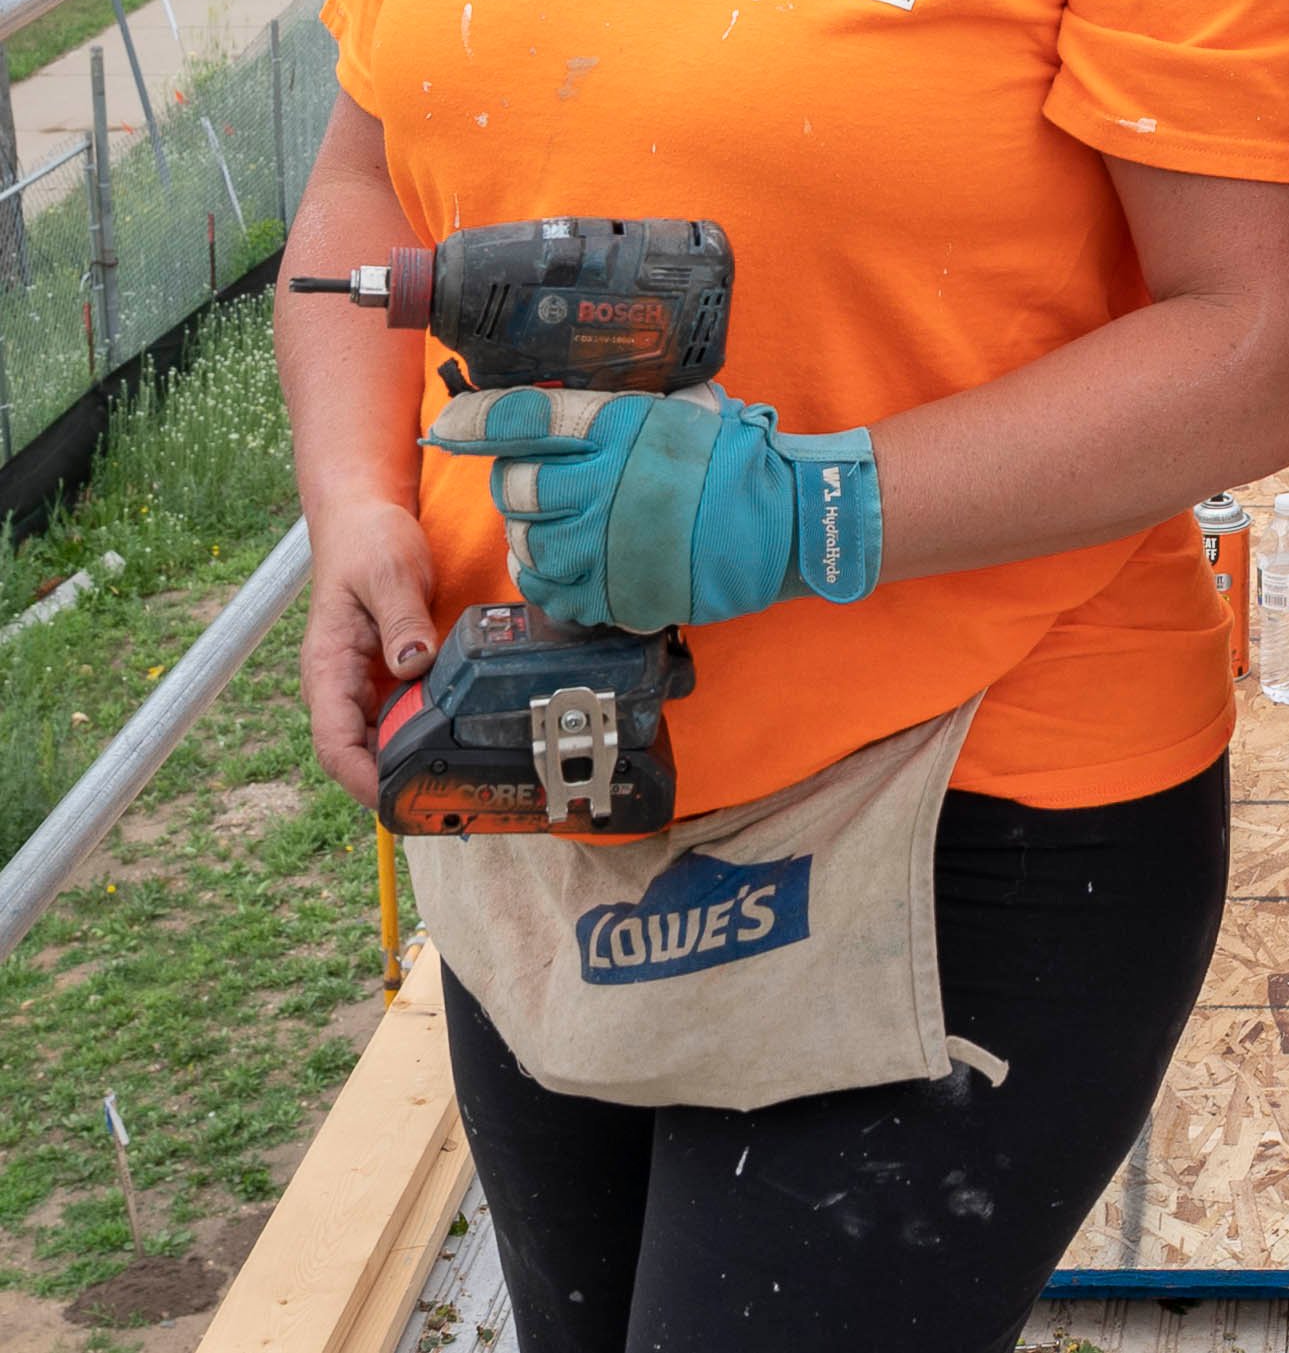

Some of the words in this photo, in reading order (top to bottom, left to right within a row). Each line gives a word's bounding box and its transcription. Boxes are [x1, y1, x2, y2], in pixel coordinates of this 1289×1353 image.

[578, 300, 663, 324] BOSCH
[822, 506, 840, 584] HydraHyde
[588, 885, 776, 968] LOWE'S
